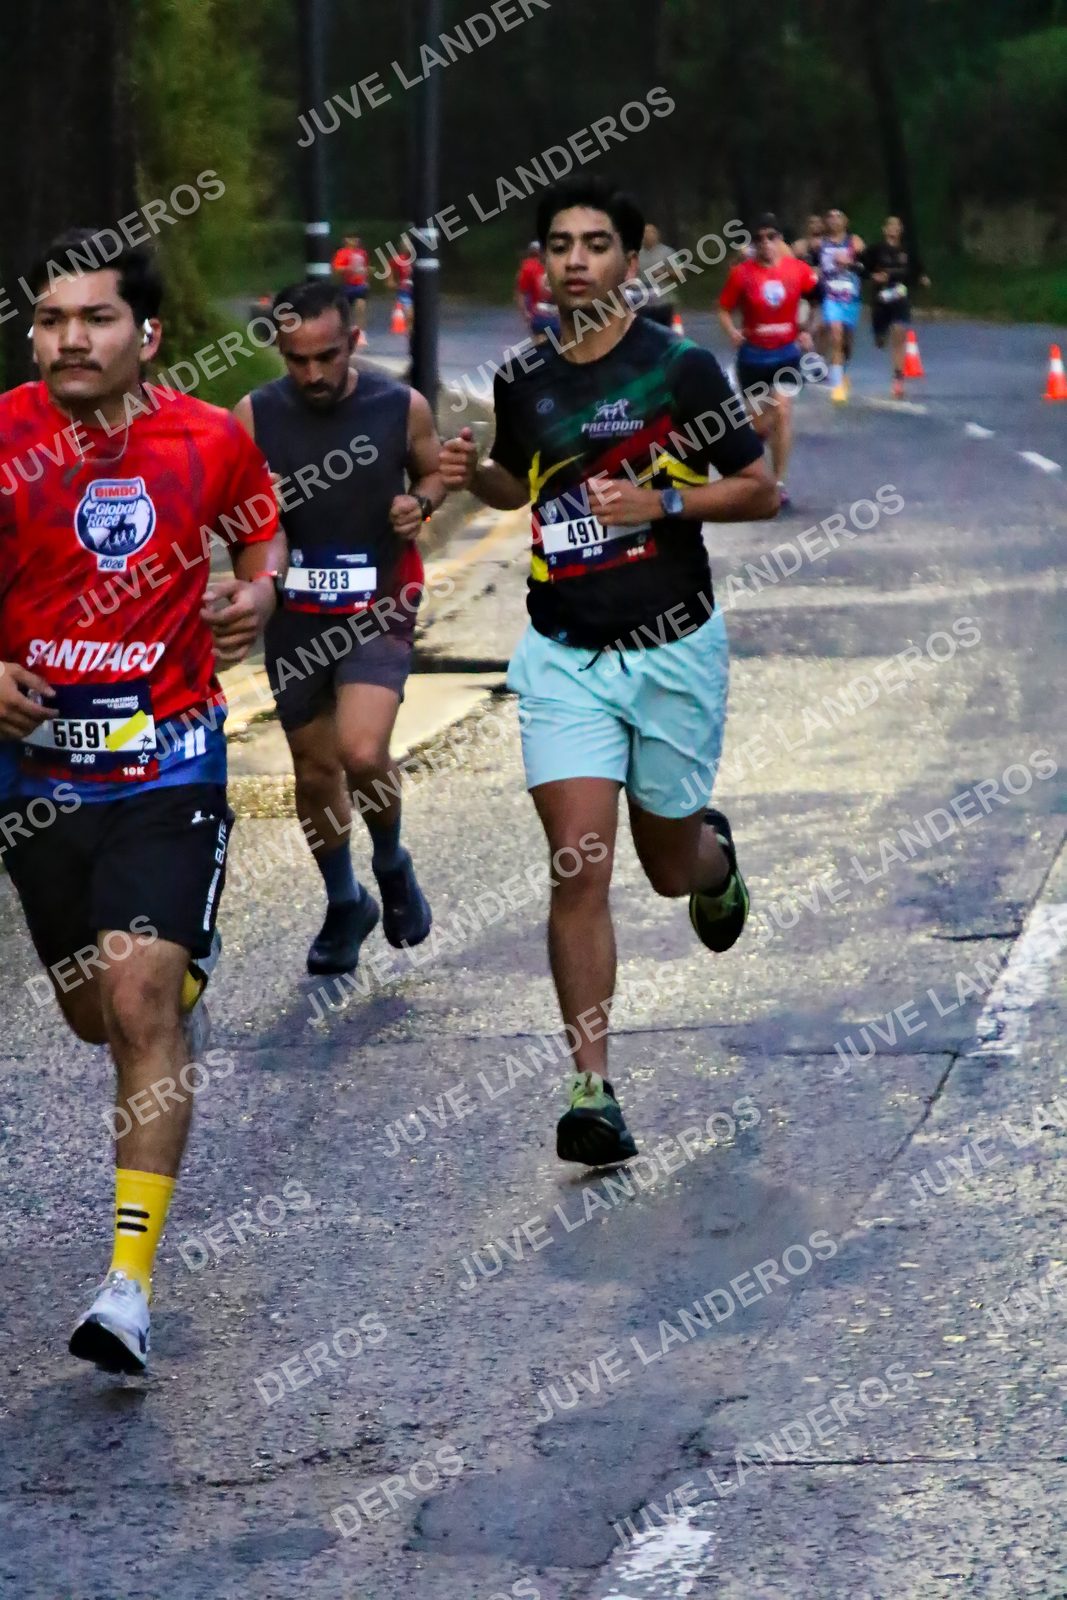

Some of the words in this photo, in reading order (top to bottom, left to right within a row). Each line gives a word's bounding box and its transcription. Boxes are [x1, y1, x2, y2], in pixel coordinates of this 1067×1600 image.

[96, 501, 137, 515] Global
[87, 513, 120, 528] Race
[100, 558, 124, 568] 2026
[308, 570, 350, 590] 5283
[26, 638, 166, 673] SANTIAGO
[53, 721, 111, 749] 5591
[122, 766, 146, 776] 10K
[215, 819, 227, 865] ELITE
